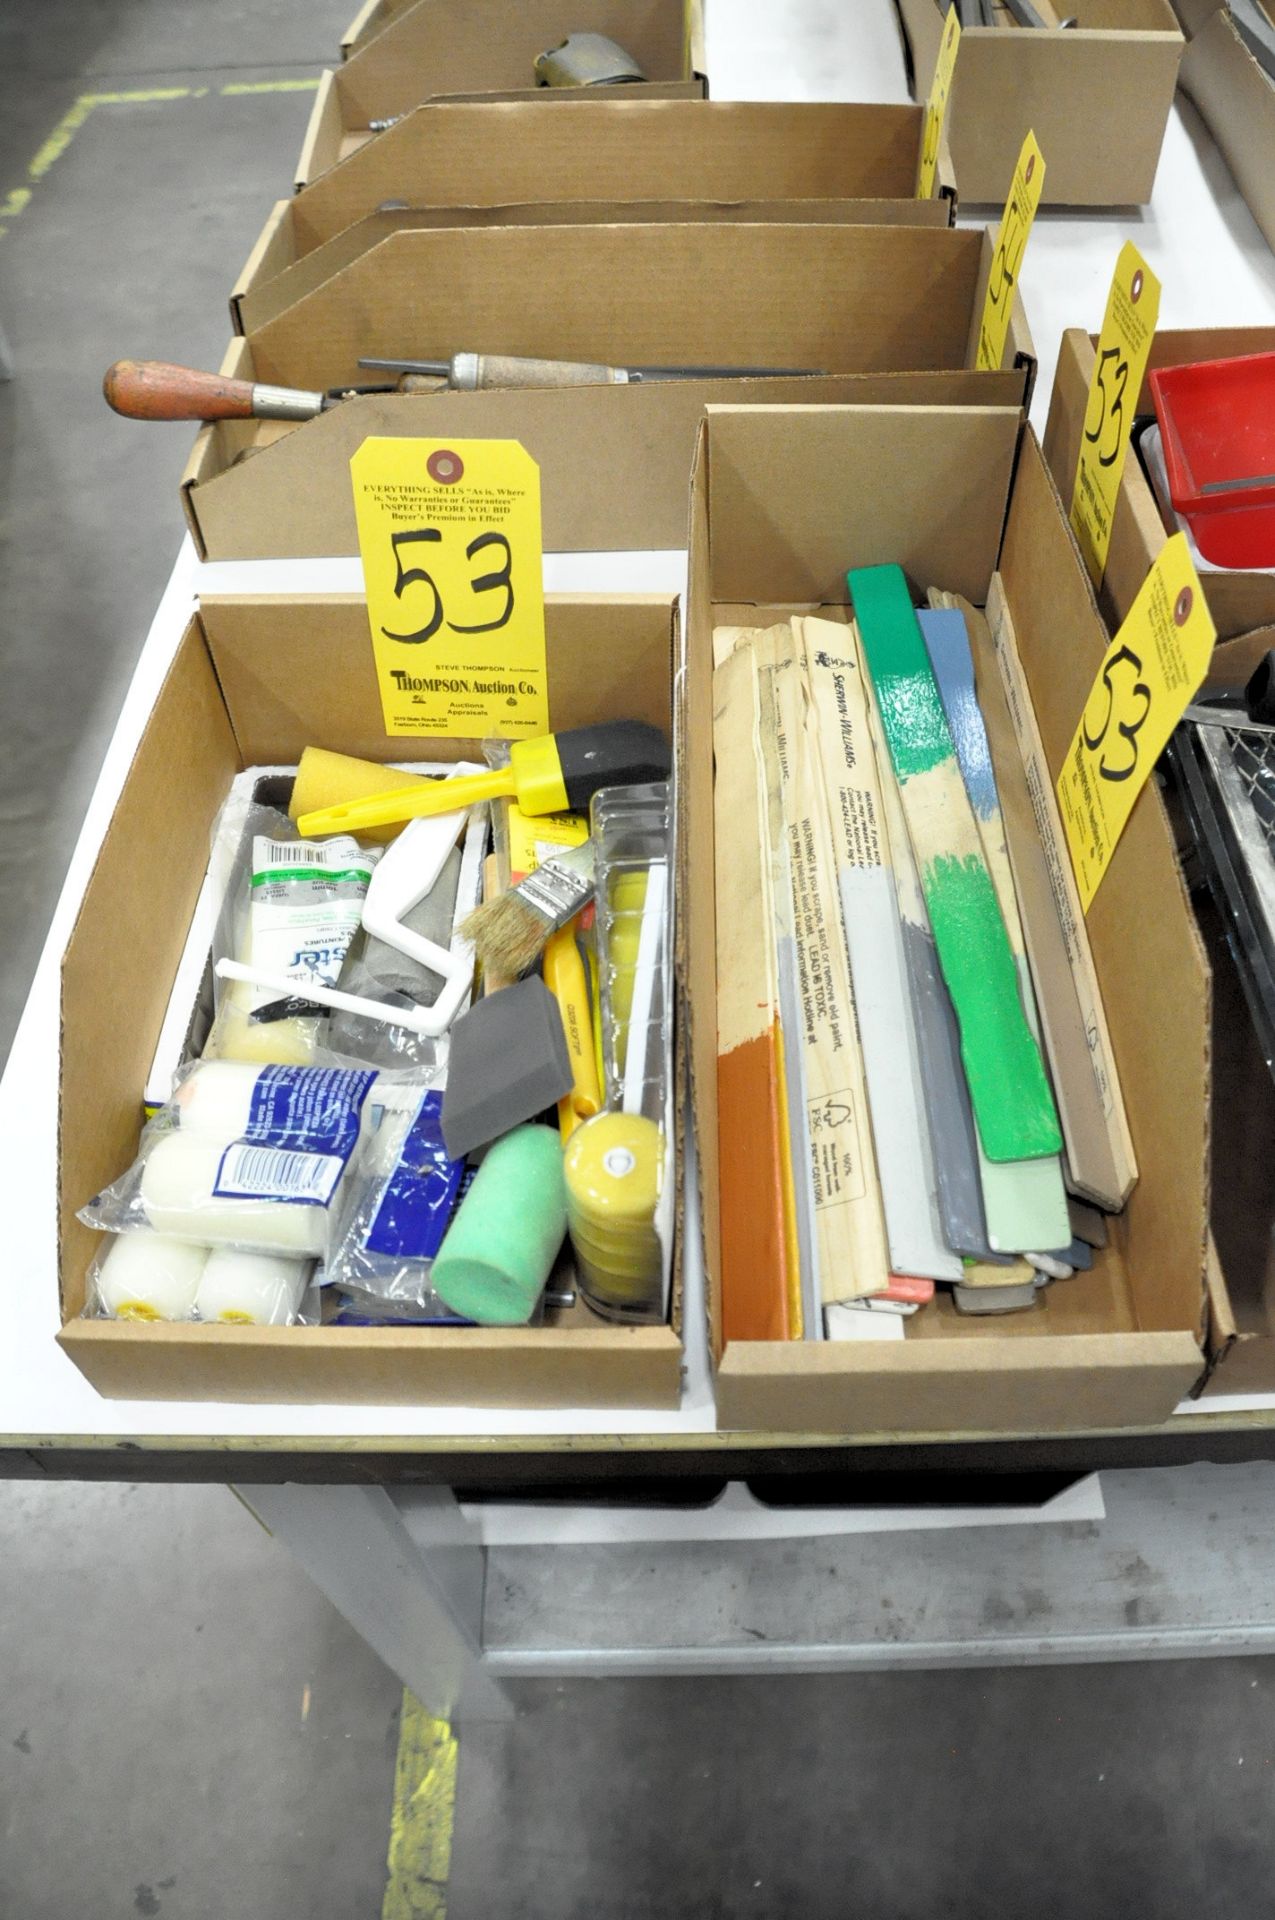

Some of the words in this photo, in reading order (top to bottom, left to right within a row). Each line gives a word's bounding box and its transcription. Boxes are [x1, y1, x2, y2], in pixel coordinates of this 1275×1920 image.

[1085, 346, 1129, 468] 53
[364, 484, 431, 495] EVERYTHING
[433, 487, 464, 496] SELLS
[496, 488, 525, 497] Where
[386, 494, 398, 503] No
[400, 494, 448, 504] Warranties
[381, 503, 422, 512] INSPECT
[426, 504, 465, 513] BEFORE
[468, 506, 490, 514] YOU
[493, 506, 511, 514] BID
[392, 512, 424, 522] Buyer's
[427, 513, 466, 522] Premium
[468, 514, 477, 522] in
[479, 515, 505, 523] Effect
[381, 528, 514, 645] 53
[473, 680, 516, 694] Auction
[518, 681, 538, 695] Co.
[1083, 644, 1151, 782] 53
[788, 822, 799, 840] you
[847, 787, 856, 813] Contact
[854, 827, 863, 854] National
[793, 841, 801, 859] may
[801, 818, 816, 865] WARNING!
[861, 820, 869, 844] release
[865, 845, 873, 860] lead
[796, 860, 806, 892] release
[808, 874, 817, 891] you
[801, 893, 811, 913] lead
[817, 928, 829, 951] sand
[797, 939, 809, 995] Information
[808, 944, 821, 972] LEAD
[822, 953, 829, 962] or
[824, 965, 834, 1001] remove
[803, 996, 815, 1032] Hotline
[814, 985, 827, 1021] TOXIC.
[829, 1004, 839, 1020] old
[808, 1034, 817, 1045] at
[829, 1022, 842, 1052] paint,
[811, 1108, 823, 1132] FSC
